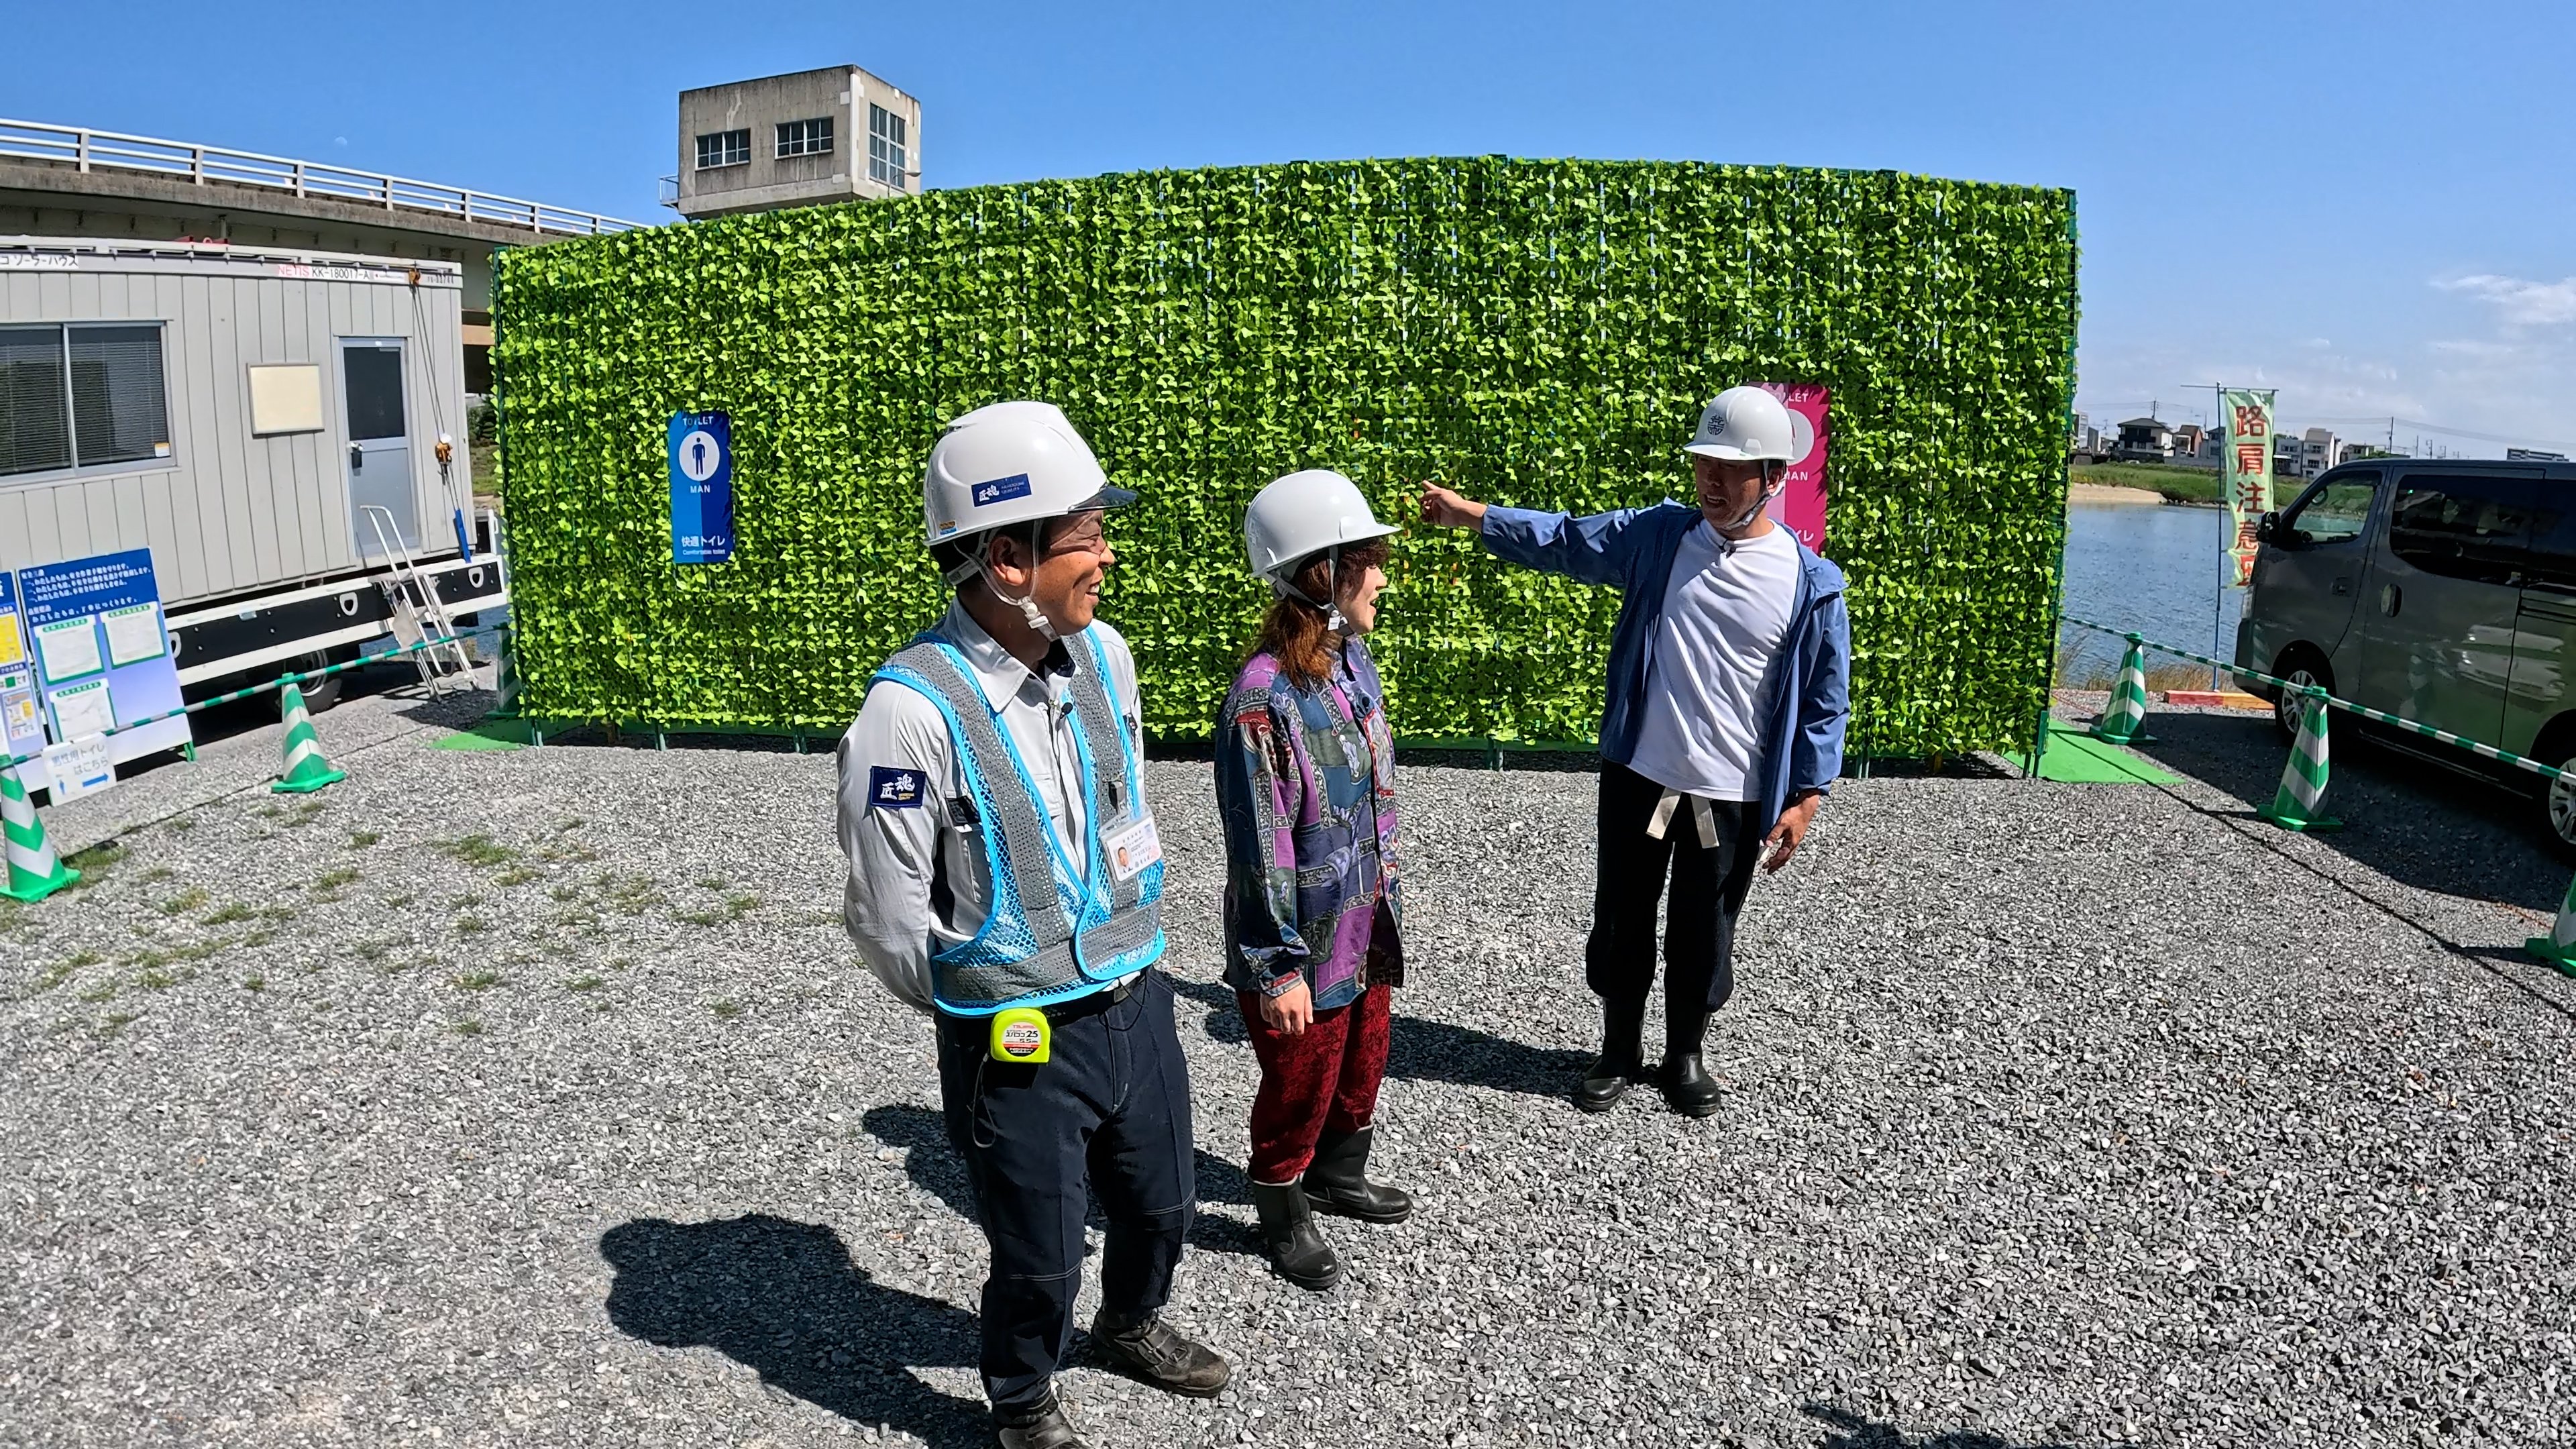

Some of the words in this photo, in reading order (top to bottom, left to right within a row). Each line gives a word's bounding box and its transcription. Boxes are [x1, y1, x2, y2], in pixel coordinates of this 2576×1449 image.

[278, 265, 309, 276] NETIS
[1788, 392, 1809, 402] LET
[682, 416, 714, 426] TOILET
[2236, 405, 2265, 549] 路肩注意
[690, 484, 711, 494] MAN
[681, 535, 726, 547] 快適トイレ
[51, 743, 105, 767] 男性用トイレ
[73, 755, 109, 775] はこちら
[1026, 1030, 1038, 1038] 25
